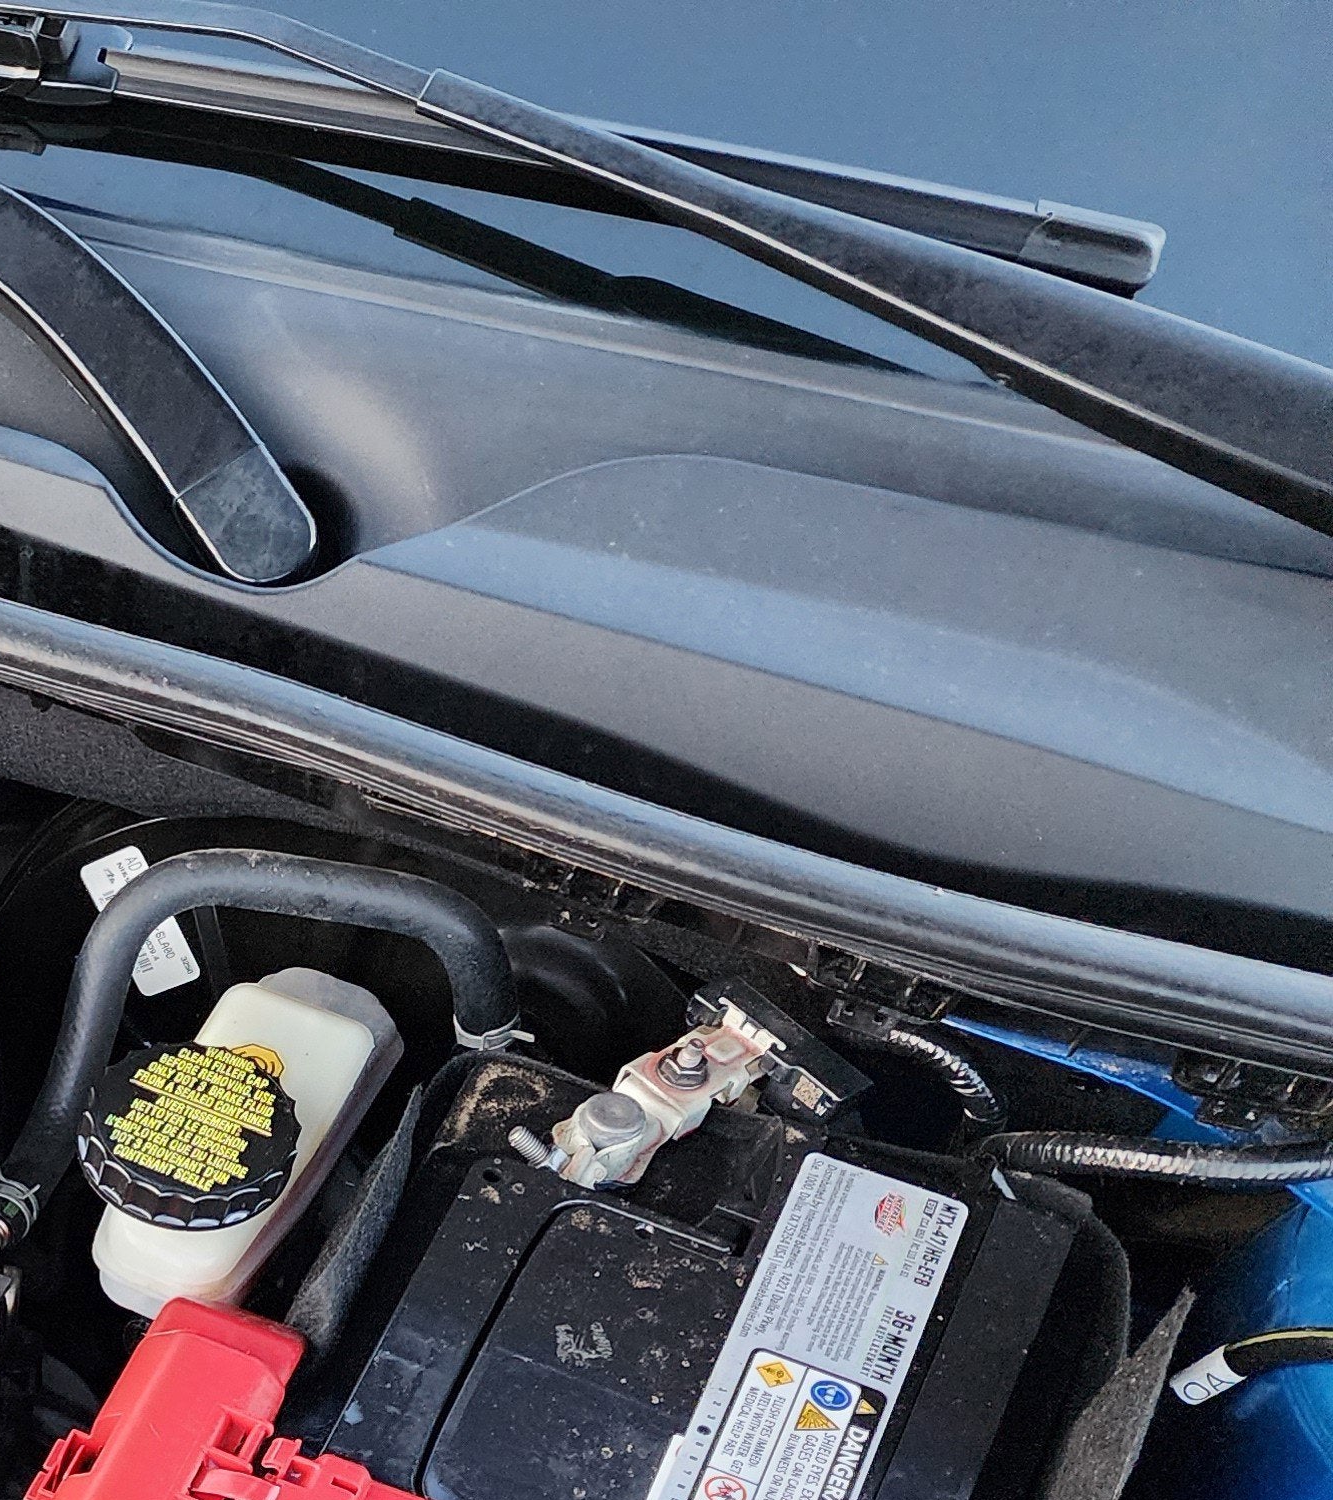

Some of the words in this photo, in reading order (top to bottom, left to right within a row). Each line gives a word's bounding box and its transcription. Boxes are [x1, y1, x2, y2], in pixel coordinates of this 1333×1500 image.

[133, 1067, 167, 1089] FROM
[173, 1083, 215, 1109] SEALED
[147, 1059, 176, 1080] ONLY
[173, 1070, 197, 1088] DOT
[207, 1083, 245, 1107] BRAKE
[242, 1096, 275, 1119] FLUID
[158, 1051, 200, 1076] BEFORE
[252, 1087, 277, 1106] USE
[209, 1059, 247, 1083] FILLER
[245, 1072, 270, 1091] CAP
[109, 1127, 136, 1147] DOT
[125, 1107, 163, 1131] AVANT
[161, 1121, 179, 1137] DE
[176, 1127, 193, 1143] LE
[184, 1118, 200, 1133] LE
[167, 1137, 193, 1157] QUE
[190, 1146, 208, 1163] DU
[205, 1152, 249, 1179] LIQUIDE
[778, 1221, 798, 1245] 75254
[909, 1201, 961, 1288] MTX-47/H5-EFB
[773, 1270, 793, 1294] 14221
[869, 1309, 917, 1385] 36-MONTH
[736, 1384, 760, 1420] MEDICAL
[754, 1389, 773, 1413] ATELY
[766, 1394, 786, 1421] FLUSH
[728, 1417, 746, 1438] HELP
[746, 1410, 764, 1433] WITH
[758, 1418, 776, 1439] EYES
[774, 1432, 800, 1475] BLINDNESS
[796, 1432, 819, 1463] GASES
[812, 1431, 837, 1466] SHIELD
[728, 1458, 744, 1475] GET
[768, 1473, 784, 1488] OR
[789, 1461, 806, 1480] CAN
